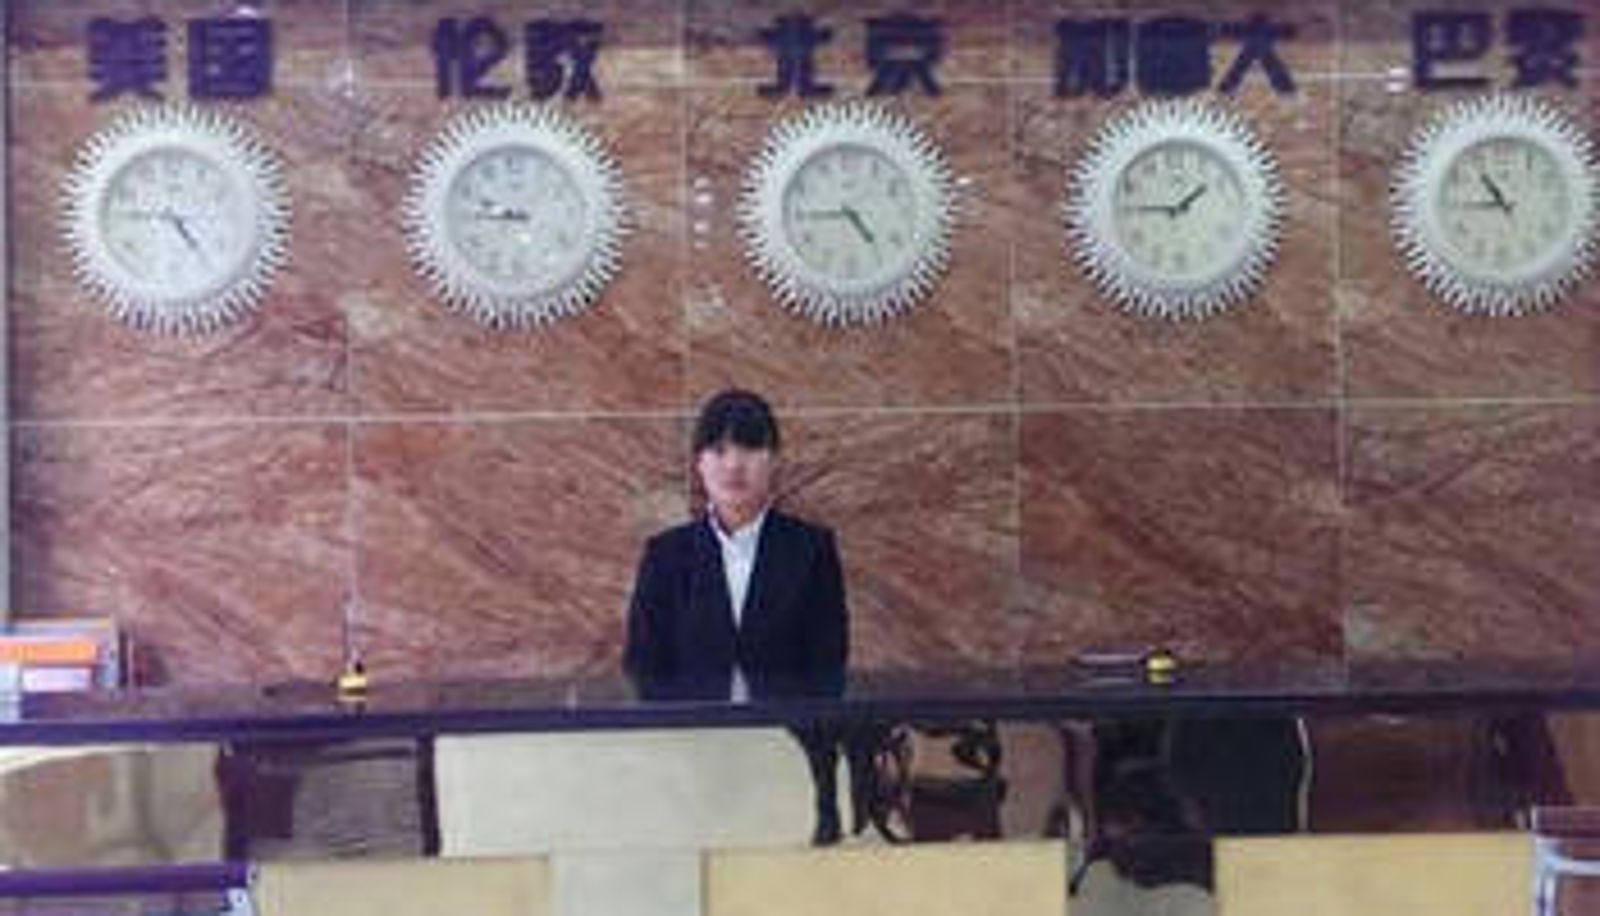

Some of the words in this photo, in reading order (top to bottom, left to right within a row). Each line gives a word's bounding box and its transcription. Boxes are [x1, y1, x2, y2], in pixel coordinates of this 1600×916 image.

[86, 18, 274, 101] 美国
[432, 17, 606, 101] 伦敦
[757, 14, 945, 97] 北京
